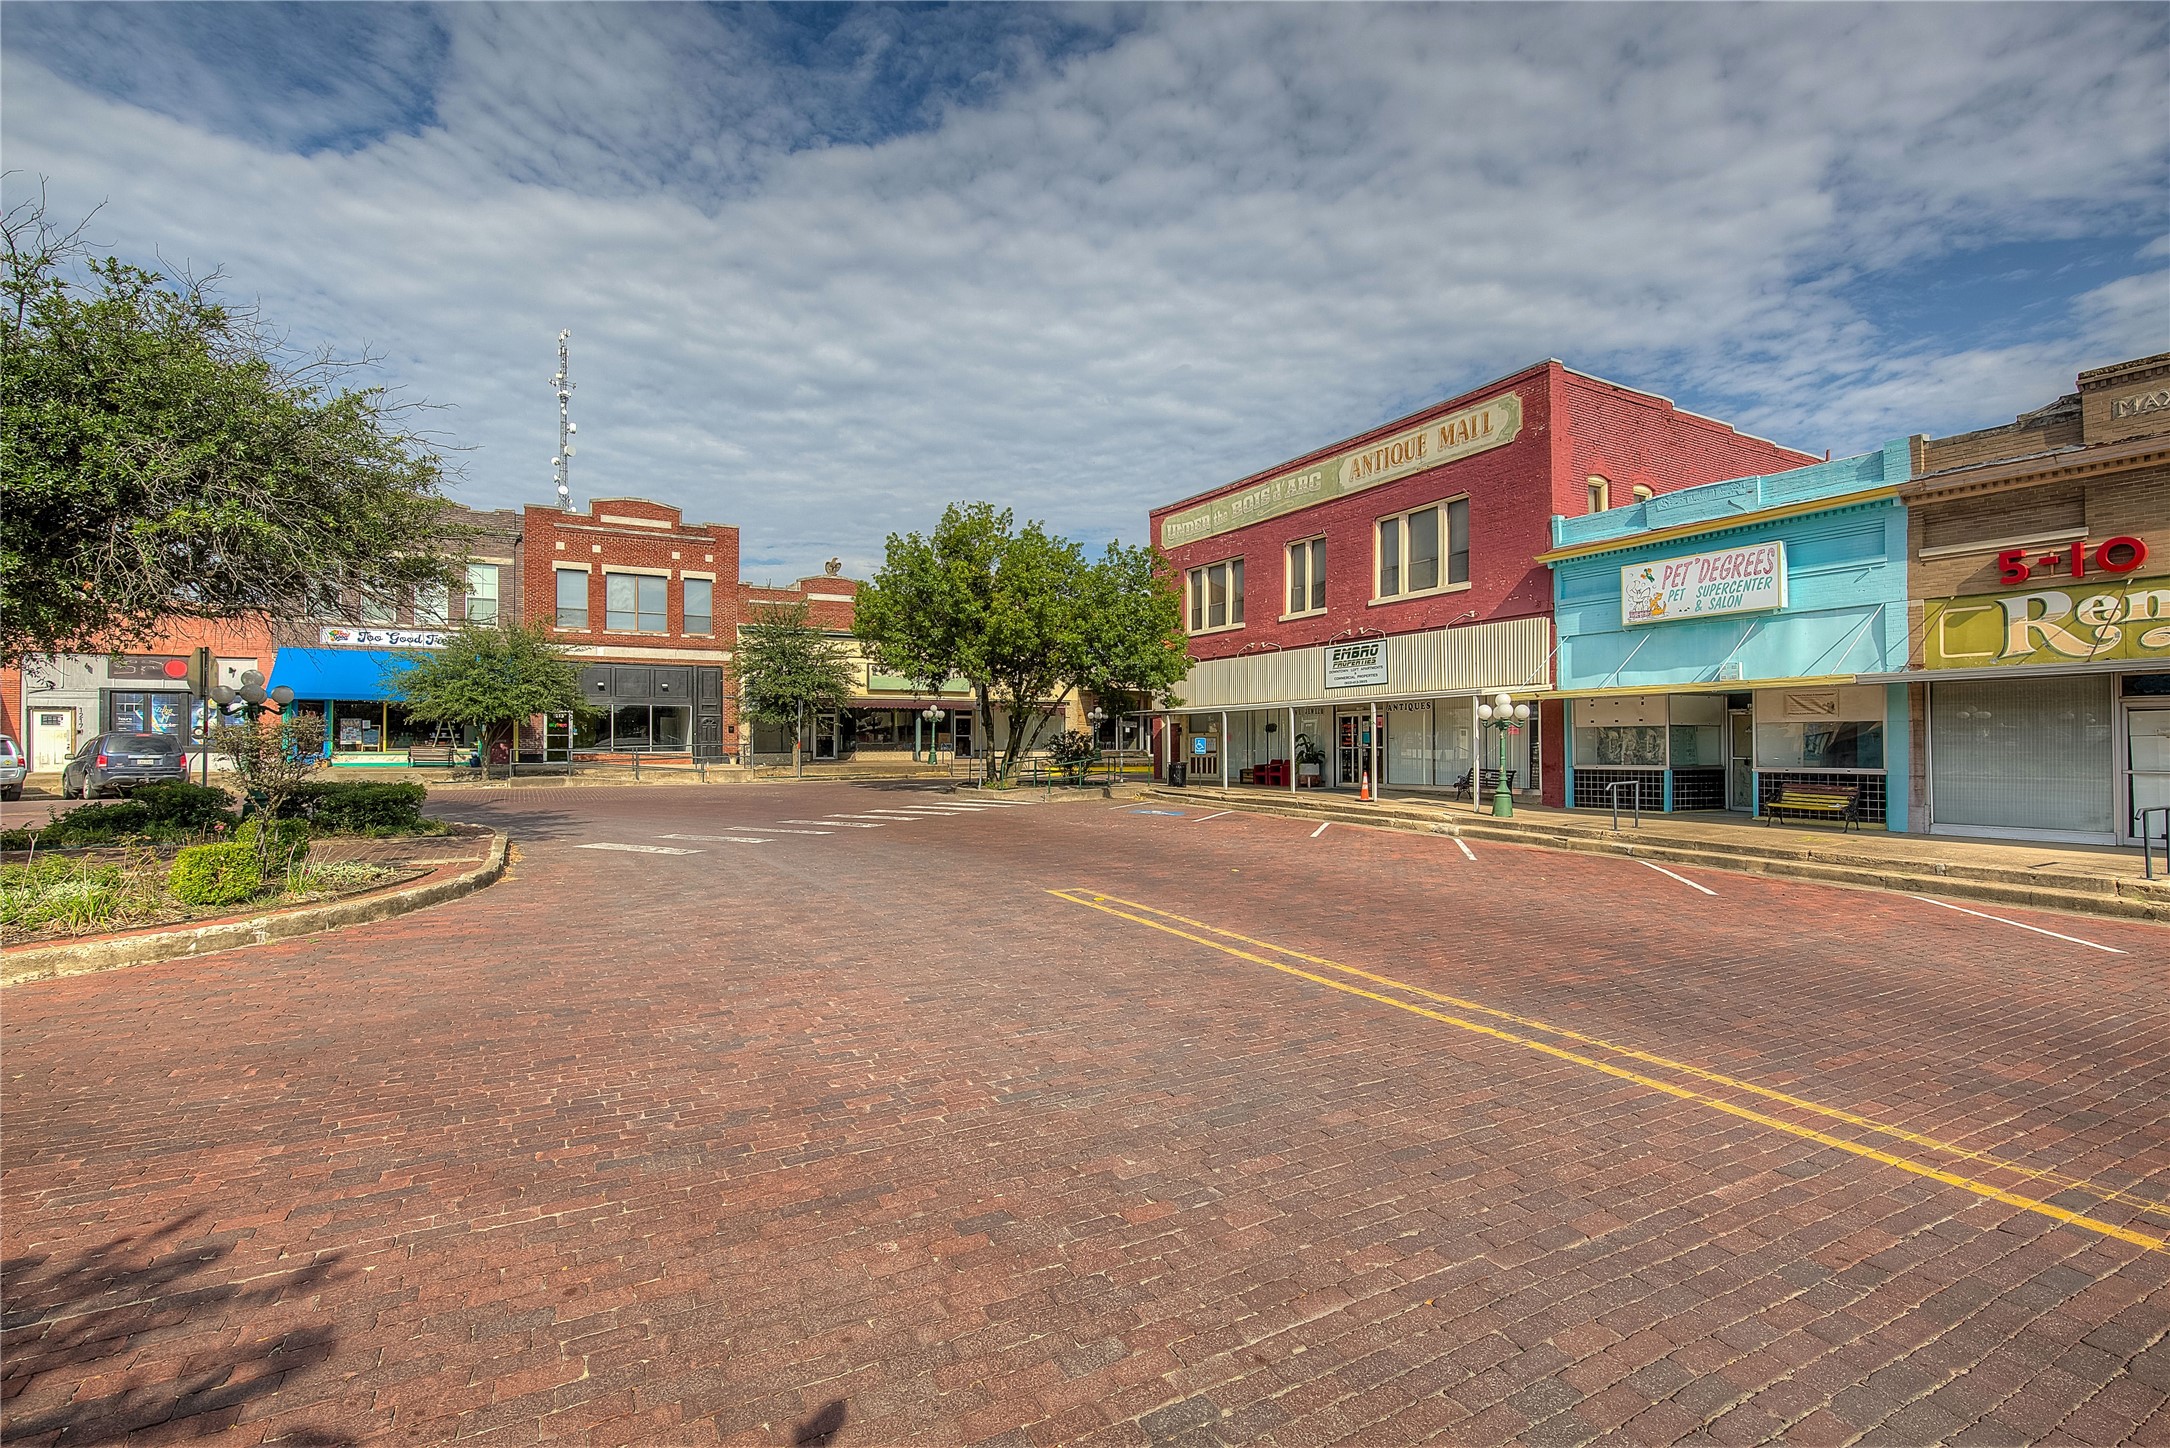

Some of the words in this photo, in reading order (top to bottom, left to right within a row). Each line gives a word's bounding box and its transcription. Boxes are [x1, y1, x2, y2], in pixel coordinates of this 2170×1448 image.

[1350, 432, 1427, 480] ANTIQUE
[1438, 411, 1493, 451] MALL
[1166, 514, 1211, 541] UNDER
[1213, 510, 1228, 526] the
[1231, 487, 1271, 519] BOIS
[1998, 536, 2149, 585] 5-10
[1667, 587, 1686, 603] PET
[1695, 576, 1773, 599] SUPERCENTER
[1694, 599, 1703, 612] &
[1708, 593, 1744, 611] SALON
[357, 631, 383, 643] Too
[386, 631, 423, 645] Good
[1332, 644, 1379, 661] EMBRO
[1332, 657, 1377, 668] PROPERTIES
[1387, 701, 1432, 712] ANTIQUES
